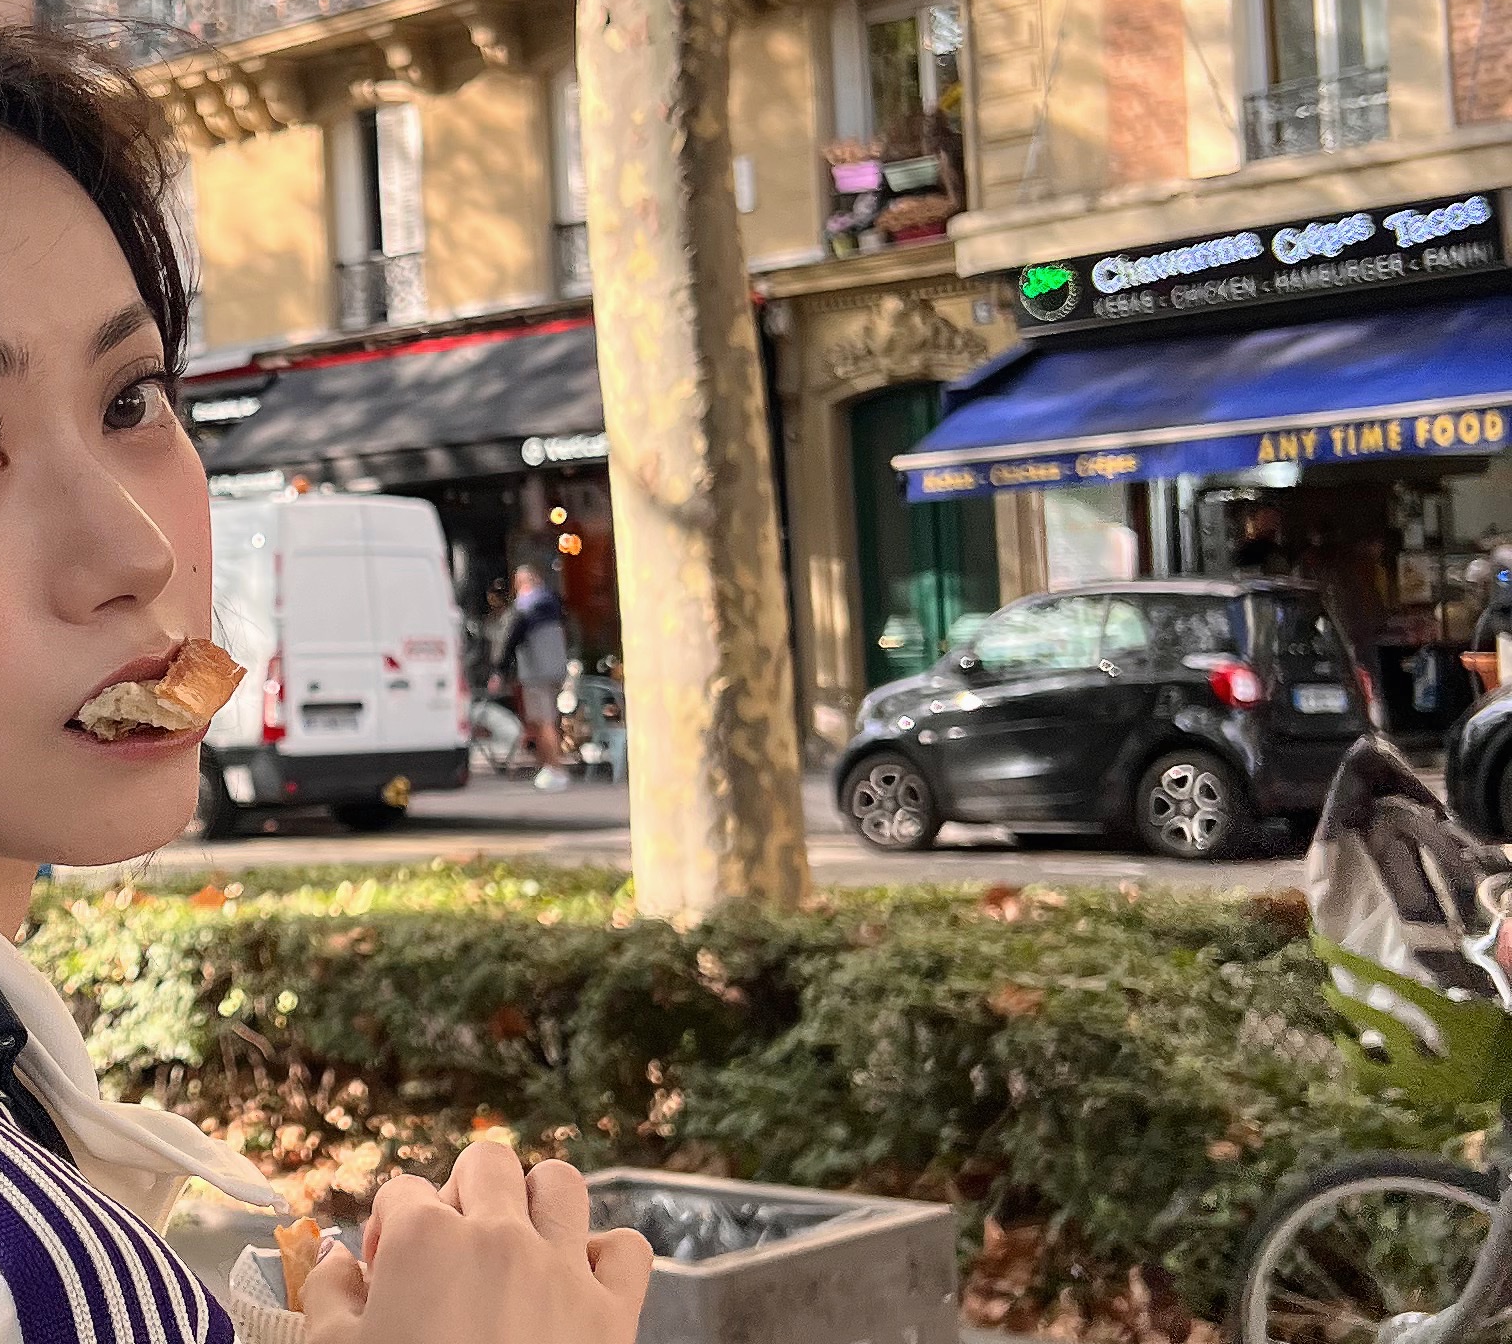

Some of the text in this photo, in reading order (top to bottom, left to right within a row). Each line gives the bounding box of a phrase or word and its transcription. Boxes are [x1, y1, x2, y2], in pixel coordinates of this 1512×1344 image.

[1383, 195, 1492, 248] Tacos
[1170, 274, 1257, 310] CHICKEN
[1275, 252, 1405, 294] HAMBURGER
[1257, 409, 1505, 463] ANY TIME FOOD
